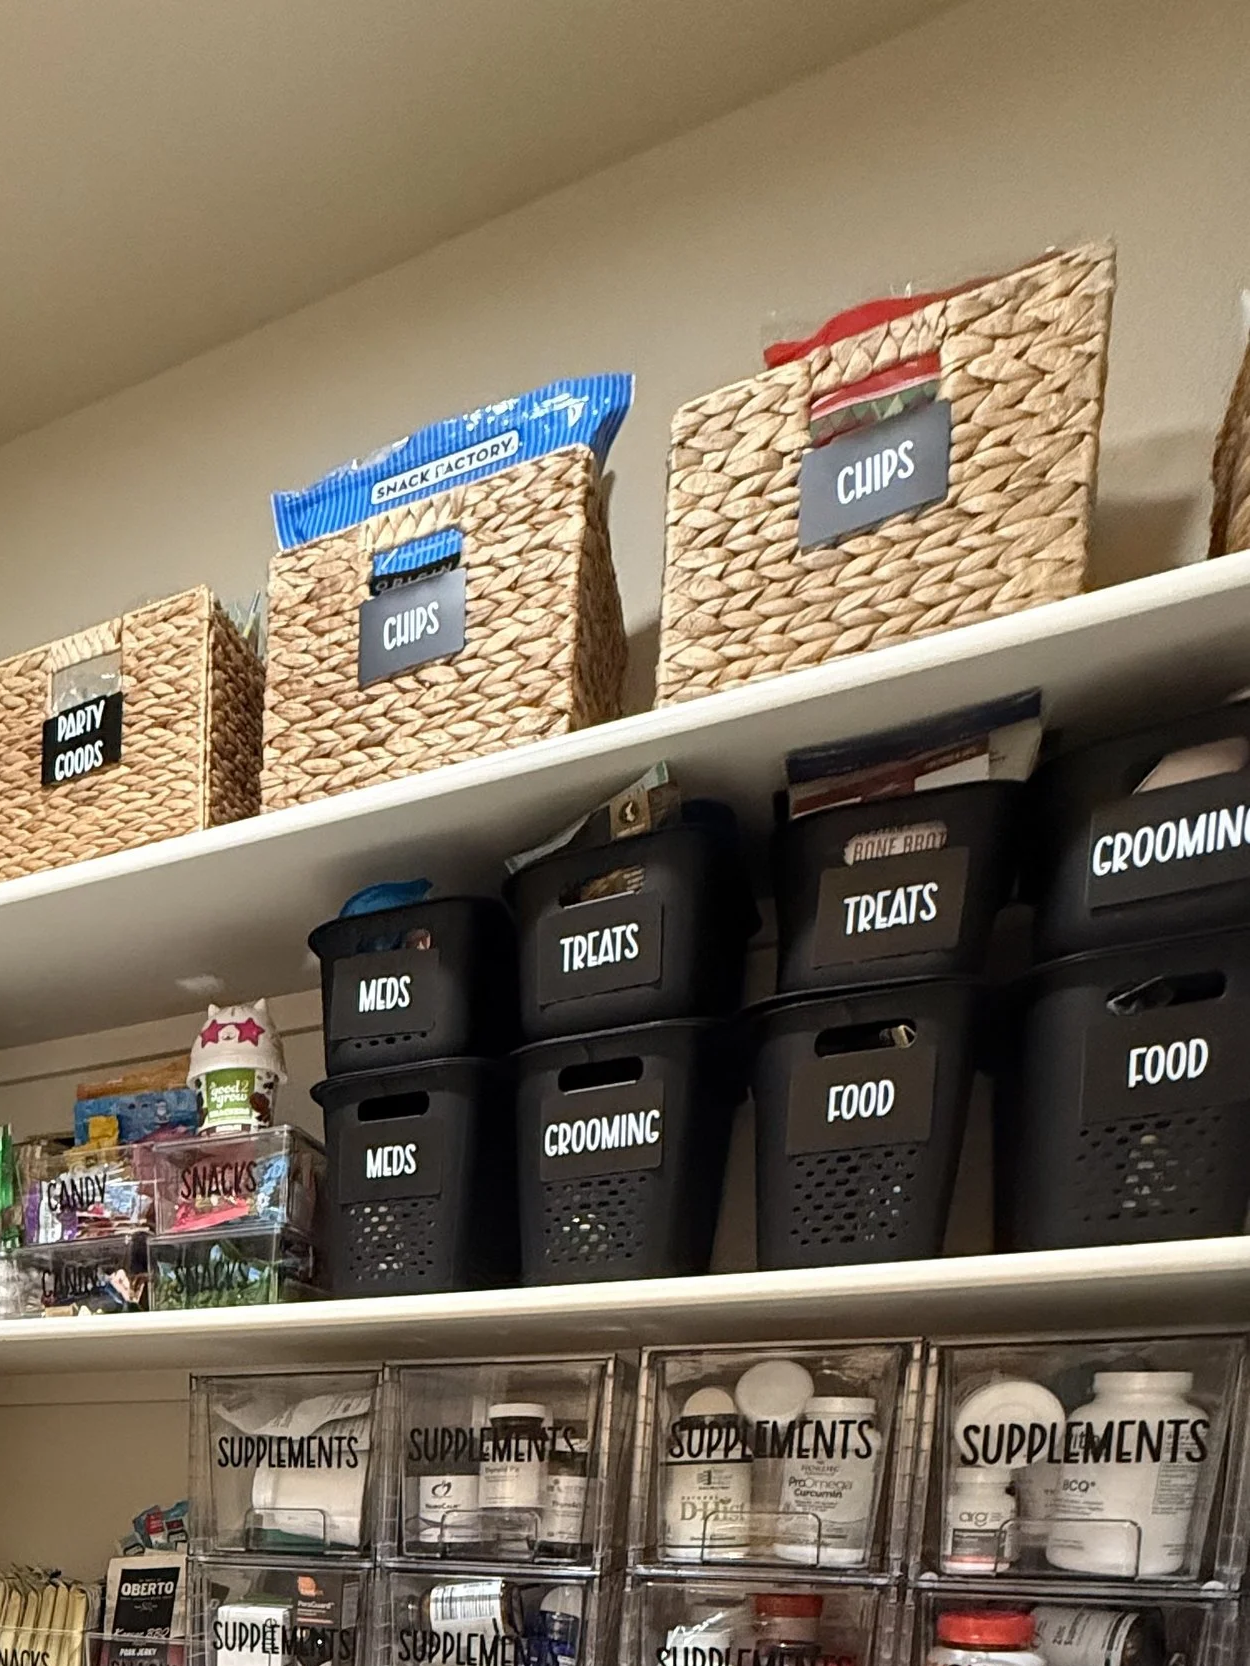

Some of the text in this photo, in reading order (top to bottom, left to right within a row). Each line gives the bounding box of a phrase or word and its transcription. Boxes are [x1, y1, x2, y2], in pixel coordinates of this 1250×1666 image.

[375, 434, 516, 502] SNACK FACTORY
[836, 440, 915, 504] CHIPS
[382, 601, 440, 651] CHIPS
[56, 699, 106, 742] PARTY
[54, 740, 104, 782] GOODS
[844, 882, 938, 935] TREATS
[560, 922, 639, 973] TREATS
[358, 975, 411, 1013] MEDS
[1127, 1038, 1209, 1088] FOOD
[827, 1079, 895, 1123] FOOD
[544, 1109, 661, 1157] GROOMING
[181, 1162, 257, 1199] SNACKS
[366, 1143, 417, 1179] MEDS
[47, 1173, 108, 1212] CANDY
[175, 1258, 251, 1296] SNACKS
[217, 1435, 359, 1470] SUPPLEMENTS
[408, 1426, 578, 1463] SUPPLEMENTS
[669, 1419, 874, 1459] SUPPLEMENTS
[960, 1418, 1210, 1465] SUPPLEMENTS
[121, 1581, 175, 1597] OBERTO
